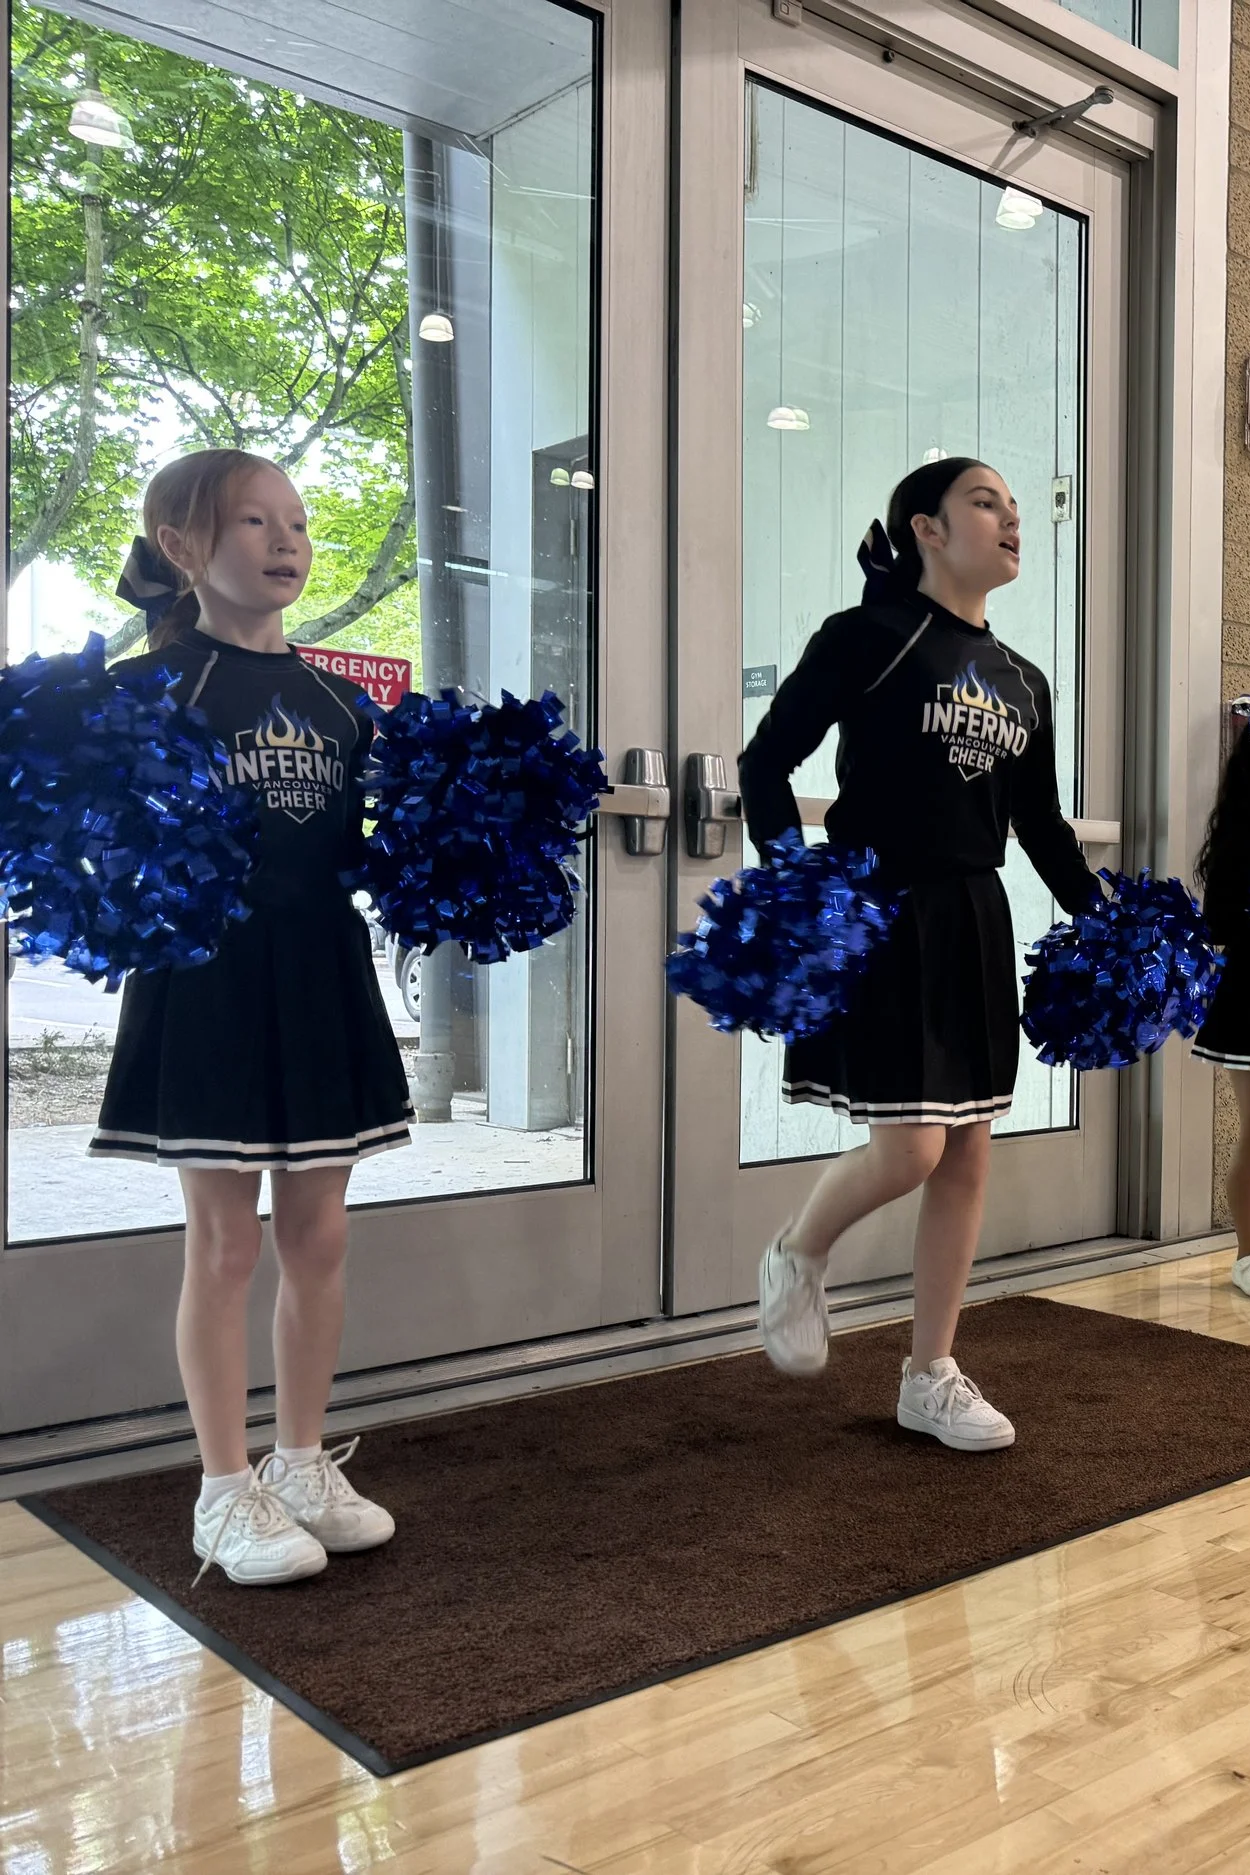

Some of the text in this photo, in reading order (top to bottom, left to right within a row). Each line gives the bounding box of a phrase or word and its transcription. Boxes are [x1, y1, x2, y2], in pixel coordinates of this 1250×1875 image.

[299, 652, 407, 683] ERGENCY
[746, 679, 766, 688] STORAGE
[922, 703, 1028, 757] INFERNO
[941, 735, 1007, 759] VANCOUVER
[948, 745, 995, 773] CHEER
[226, 748, 345, 793] INFERNO
[252, 779, 333, 796] VANCOUVER
[267, 790, 326, 812] CHEER
